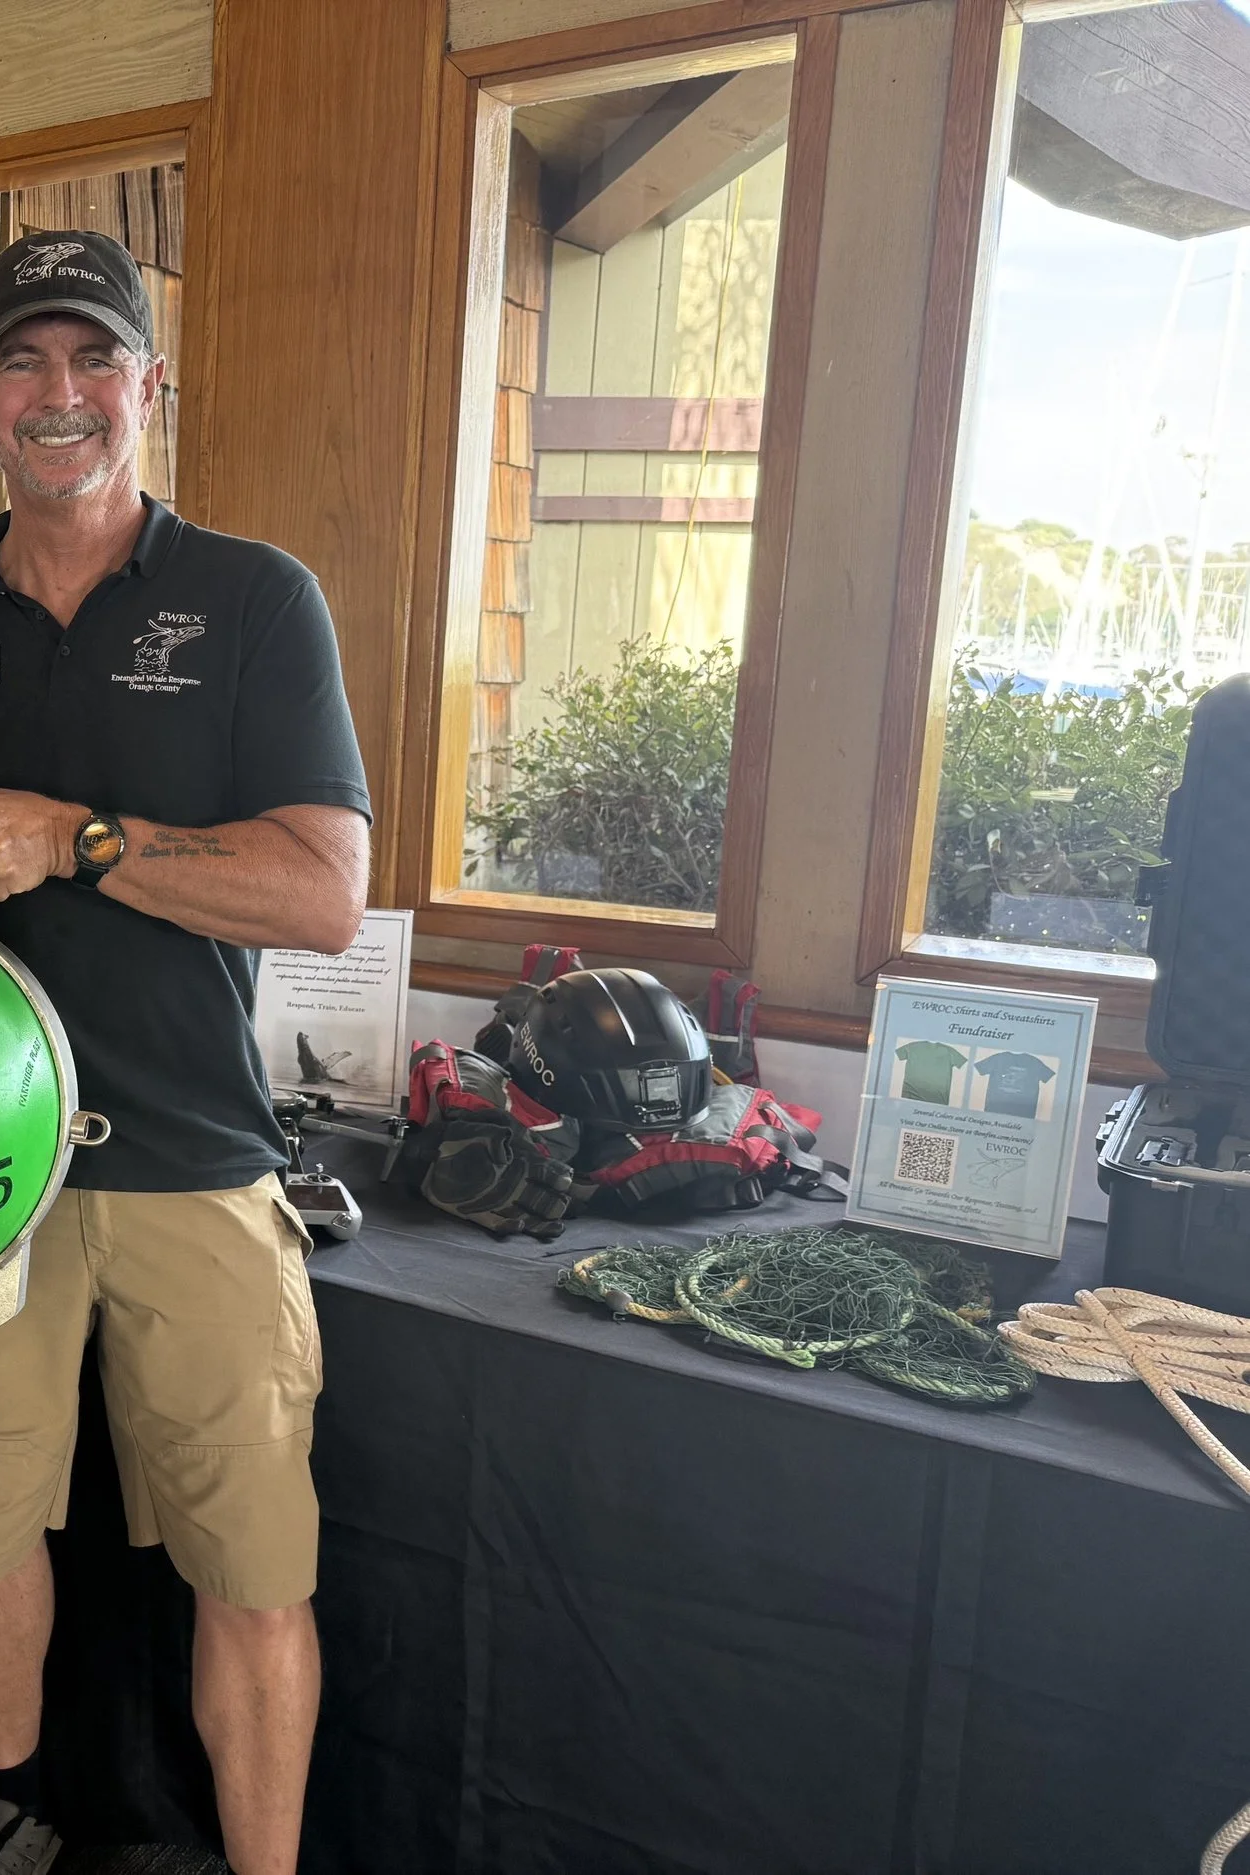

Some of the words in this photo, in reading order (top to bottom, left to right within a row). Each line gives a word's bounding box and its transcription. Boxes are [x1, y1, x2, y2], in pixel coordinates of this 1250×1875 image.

[58, 267, 106, 285] EWROC
[157, 611, 207, 625] EWROC
[111, 673, 145, 684] Entangled
[145, 674, 167, 684] Whale
[168, 676, 201, 687] Response
[128, 683, 153, 693] Orange
[154, 684, 181, 694] County
[287, 1001, 315, 1010] Respond,
[912, 1001, 952, 1013] EWROC
[952, 1006, 980, 1017] Shirts
[981, 1010, 1001, 1019] and
[1000, 1012, 1056, 1026] Sweatshirts
[948, 1022, 1015, 1041] Fundraiser
[520, 1022, 556, 1087] EWROC
[986, 1142, 1028, 1157] EWROC
